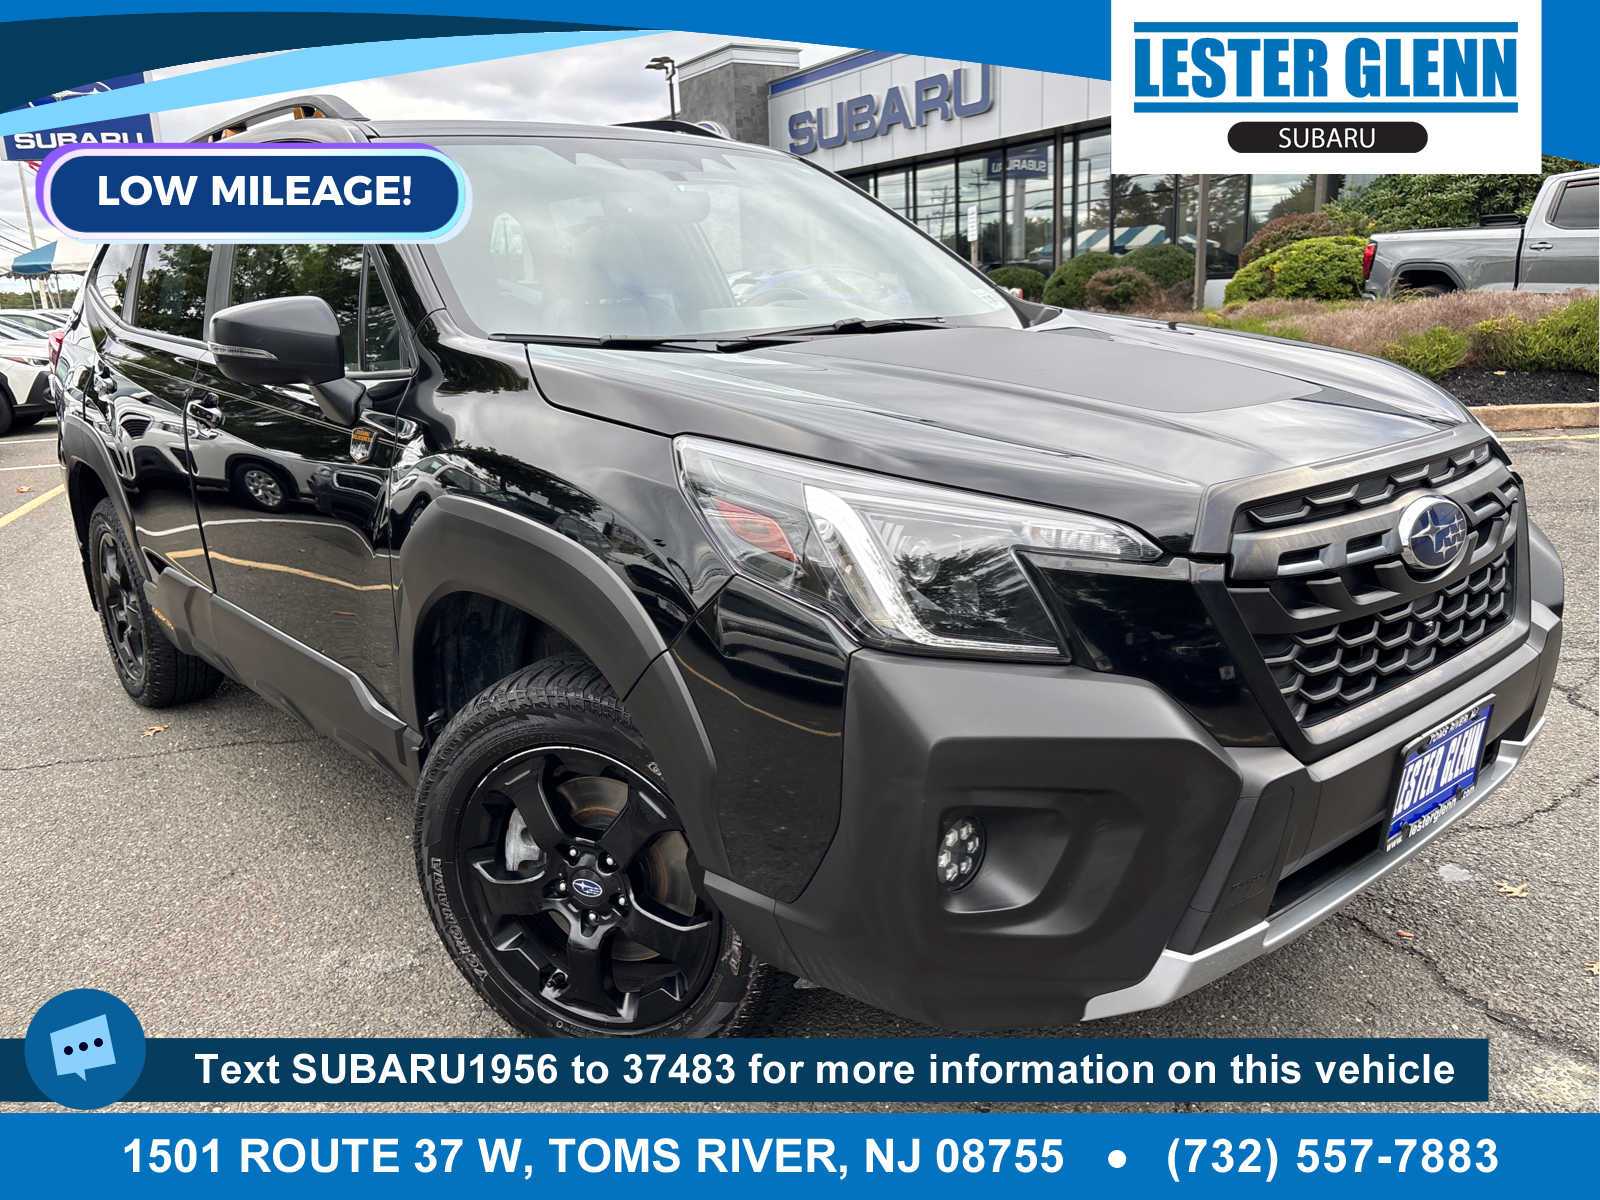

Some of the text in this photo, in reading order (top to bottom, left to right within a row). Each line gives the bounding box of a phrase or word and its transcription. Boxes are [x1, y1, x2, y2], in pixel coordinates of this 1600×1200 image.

[788, 64, 993, 156] SUBARU
[1392, 720, 1486, 819] LESTER GLENN
